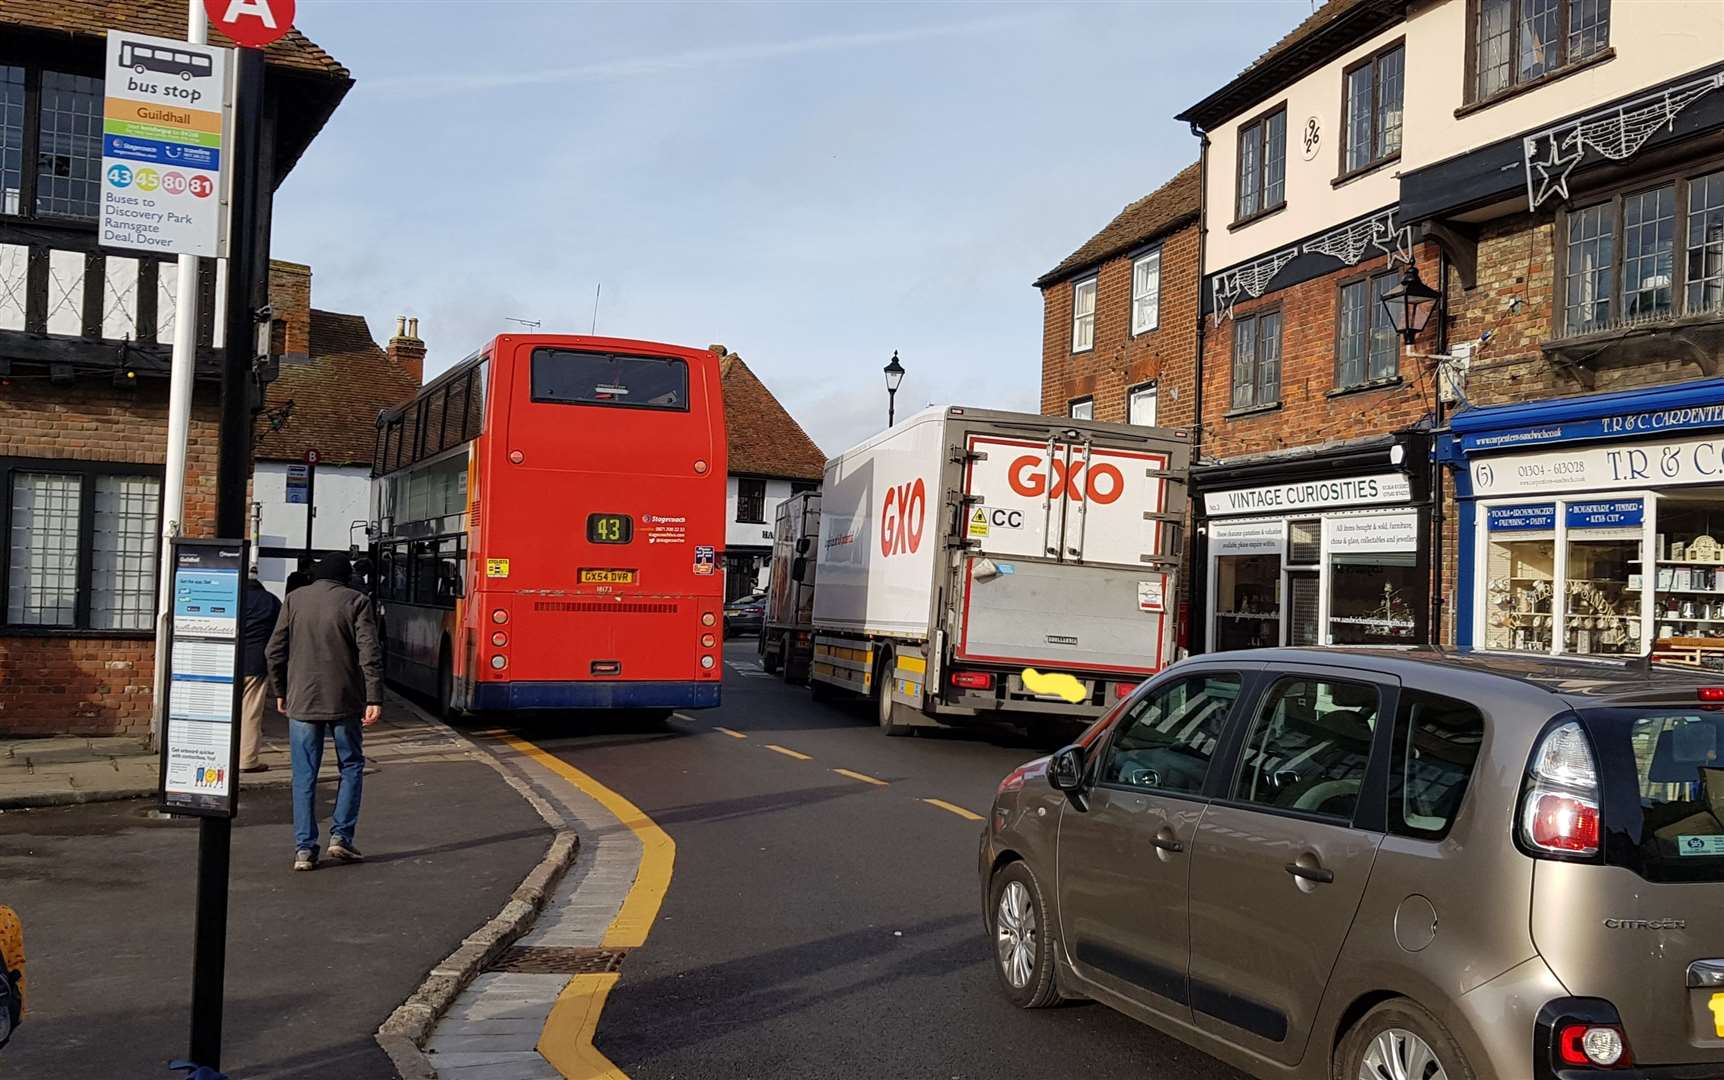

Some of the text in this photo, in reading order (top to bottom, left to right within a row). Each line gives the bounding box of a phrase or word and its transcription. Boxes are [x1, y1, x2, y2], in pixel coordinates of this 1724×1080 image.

[127, 77, 202, 104] bus stop
[137, 107, 191, 125] Guildhall
[108, 169, 212, 194] 43 45 80 81
[106, 192, 155, 207] Buses to
[105, 205, 193, 225] Discovery Park
[105, 217, 160, 234] Ramsgate
[136, 234, 174, 247] Dover
[1625, 415, 1637, 430] &
[309, 451, 316, 461] B
[1660, 447, 1681, 478] &
[1518, 463, 1545, 477] 01304
[1553, 461, 1585, 476] 613028
[1008, 455, 1124, 505] GXO
[1229, 479, 1379, 509] VINTAGE CURIOSITIES
[1491, 509, 1511, 518] TOOLS
[1615, 503, 1638, 512] TIMBER
[652, 516, 686, 525] Stagecoach
[880, 477, 925, 558] GXO
[992, 509, 1022, 528] CC
[1529, 517, 1547, 525] PAINT
[1590, 514, 1620, 523] KEYS CUT
[597, 519, 621, 540] 43
[585, 572, 630, 582] GX54 DVR
[1604, 917, 1687, 930] CITROËN
